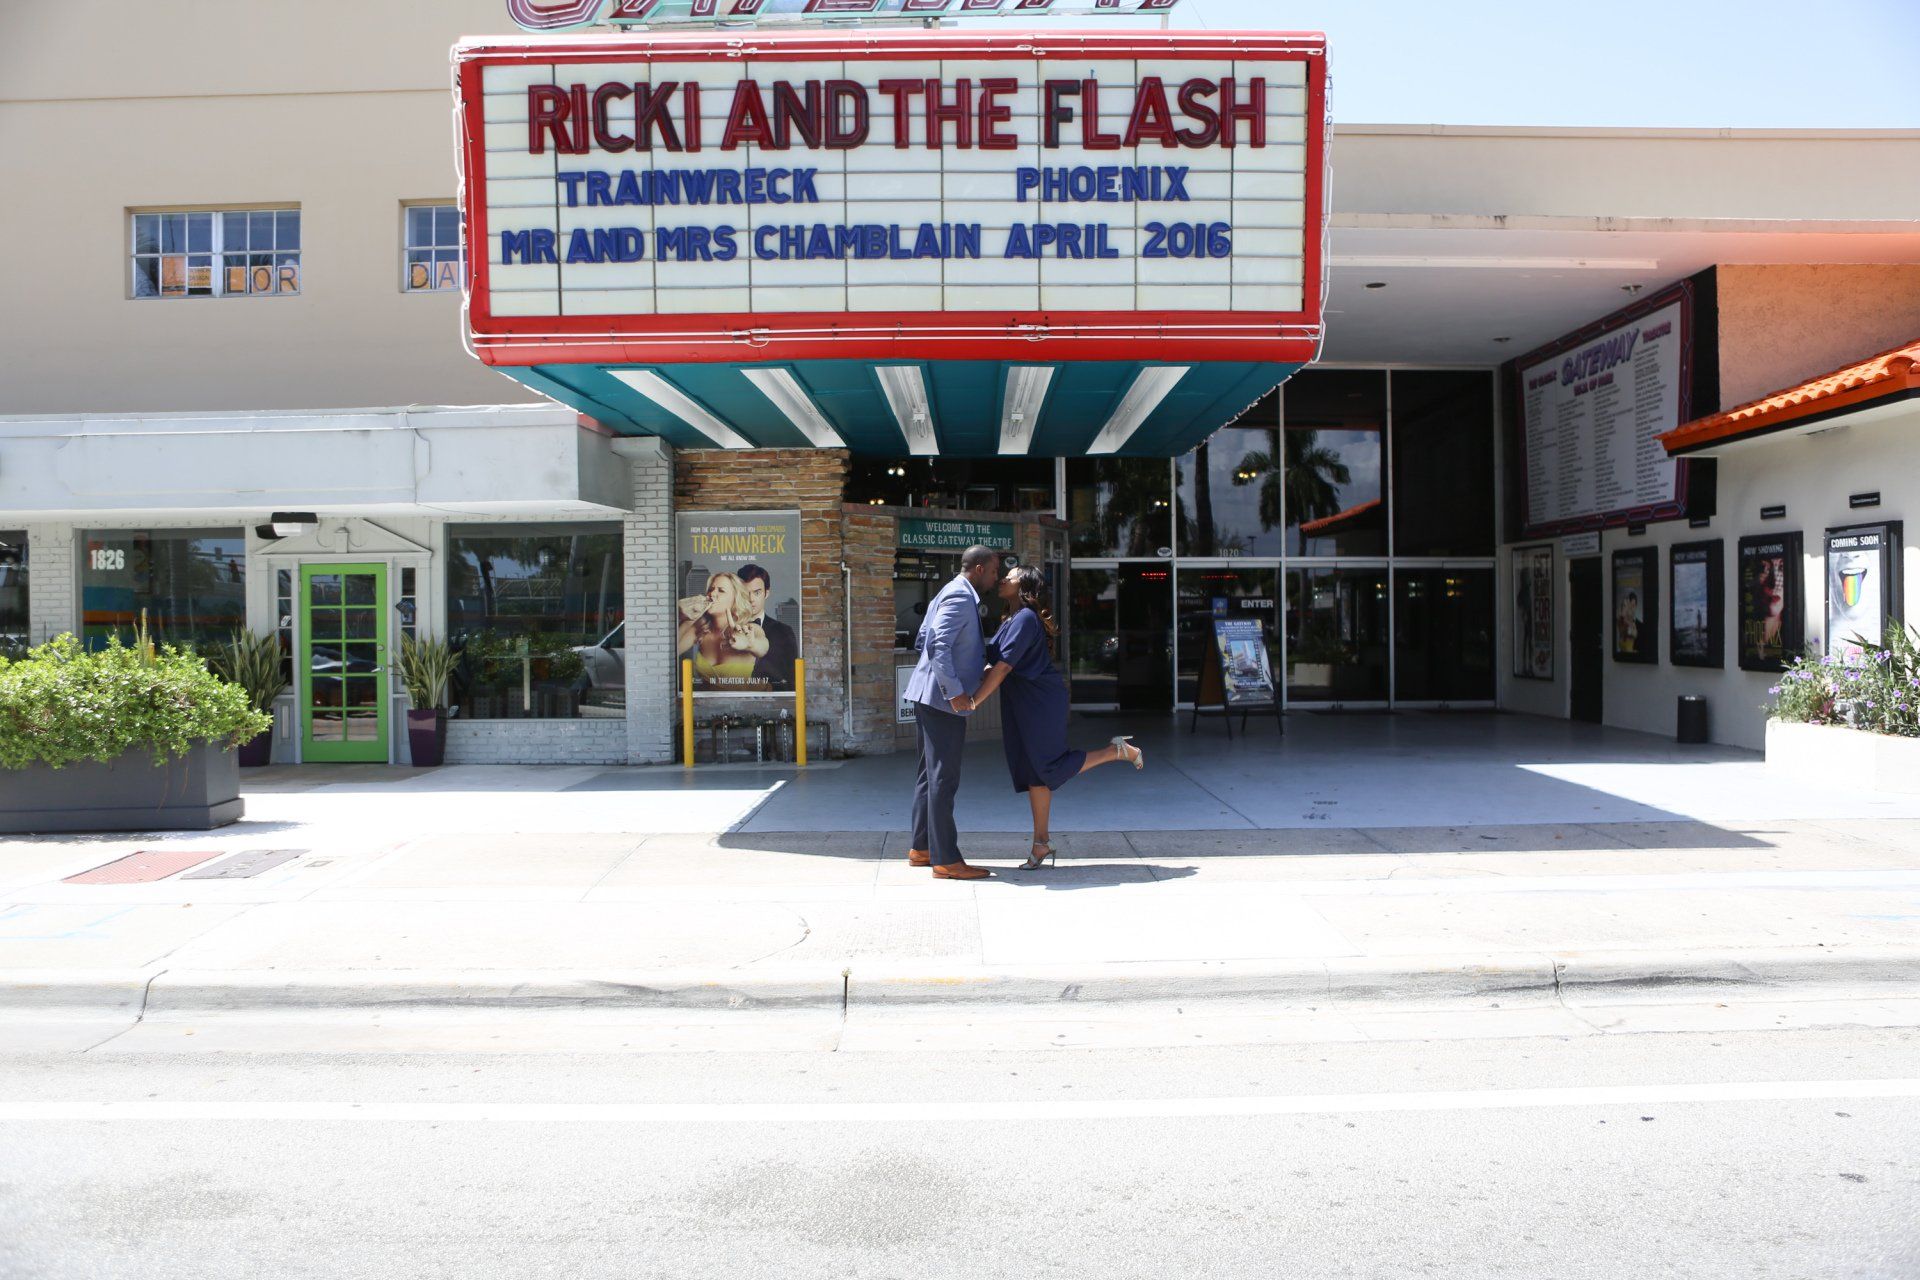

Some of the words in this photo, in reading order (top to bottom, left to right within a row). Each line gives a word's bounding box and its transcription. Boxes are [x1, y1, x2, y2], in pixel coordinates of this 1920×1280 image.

[528, 81, 701, 155] RICKI
[720, 79, 870, 152] AND
[878, 78, 1018, 150] THE
[1044, 76, 1266, 150] FLASH
[558, 167, 819, 208] TRAINWRECK
[1016, 166, 1190, 202] PHOENIX
[501, 229, 558, 265] MR
[566, 227, 645, 264] AND
[656, 225, 737, 262] MRS
[754, 223, 981, 261] CHAMBLAIN
[1004, 222, 1119, 259] APRIL
[1143, 221, 1231, 258] 2016
[1561, 328, 1640, 386] GATEWAY
[926, 522, 962, 533] WELCOME
[965, 523, 975, 533] TO
[977, 524, 991, 534] THE
[691, 534, 785, 554] TRAINWRECK
[902, 533, 936, 544] CLASSIC
[938, 535, 976, 546] GATEWAY
[978, 537, 1012, 547] THEATRE
[1831, 537, 1858, 548] COMING
[1860, 535, 1879, 546] SOON
[1743, 545, 1757, 556] NOW
[1758, 544, 1784, 555] SHOWING
[90, 549, 125, 570] 1826
[1241, 599, 1274, 609] ENTER
[709, 677, 716, 685] IN
[718, 677, 745, 685] THEATERS
[746, 677, 761, 685] JULY
